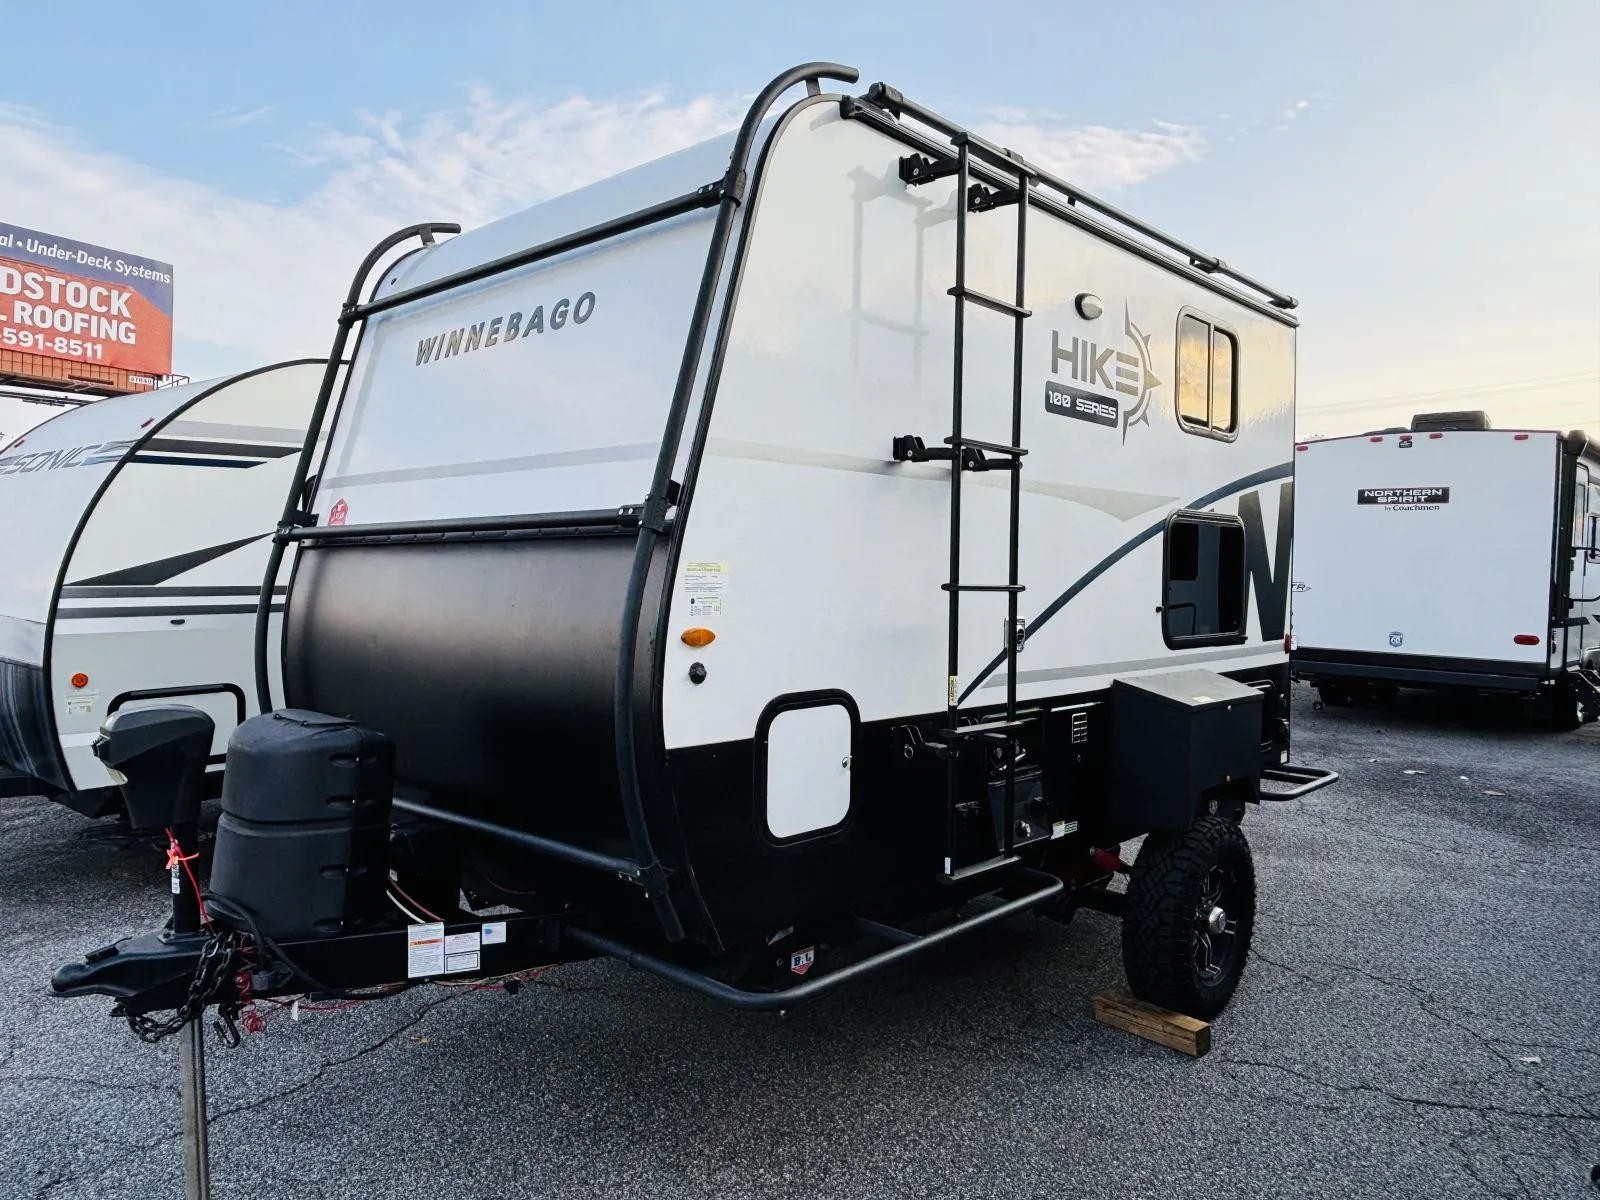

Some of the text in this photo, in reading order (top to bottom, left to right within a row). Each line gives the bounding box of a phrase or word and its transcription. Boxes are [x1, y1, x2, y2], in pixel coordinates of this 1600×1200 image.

[26, 238, 113, 271] Under-Deck
[115, 259, 171, 284] Systems
[0, 266, 132, 319] DSTOCK
[13, 300, 137, 345] ROOFING
[415, 291, 596, 366] WINNEBAGO
[1051, 329, 1140, 397] HIKE
[1048, 391, 1117, 419] 100 SERIES
[1364, 488, 1443, 497] NORTHERN
[1377, 495, 1428, 503] SPIRIT
